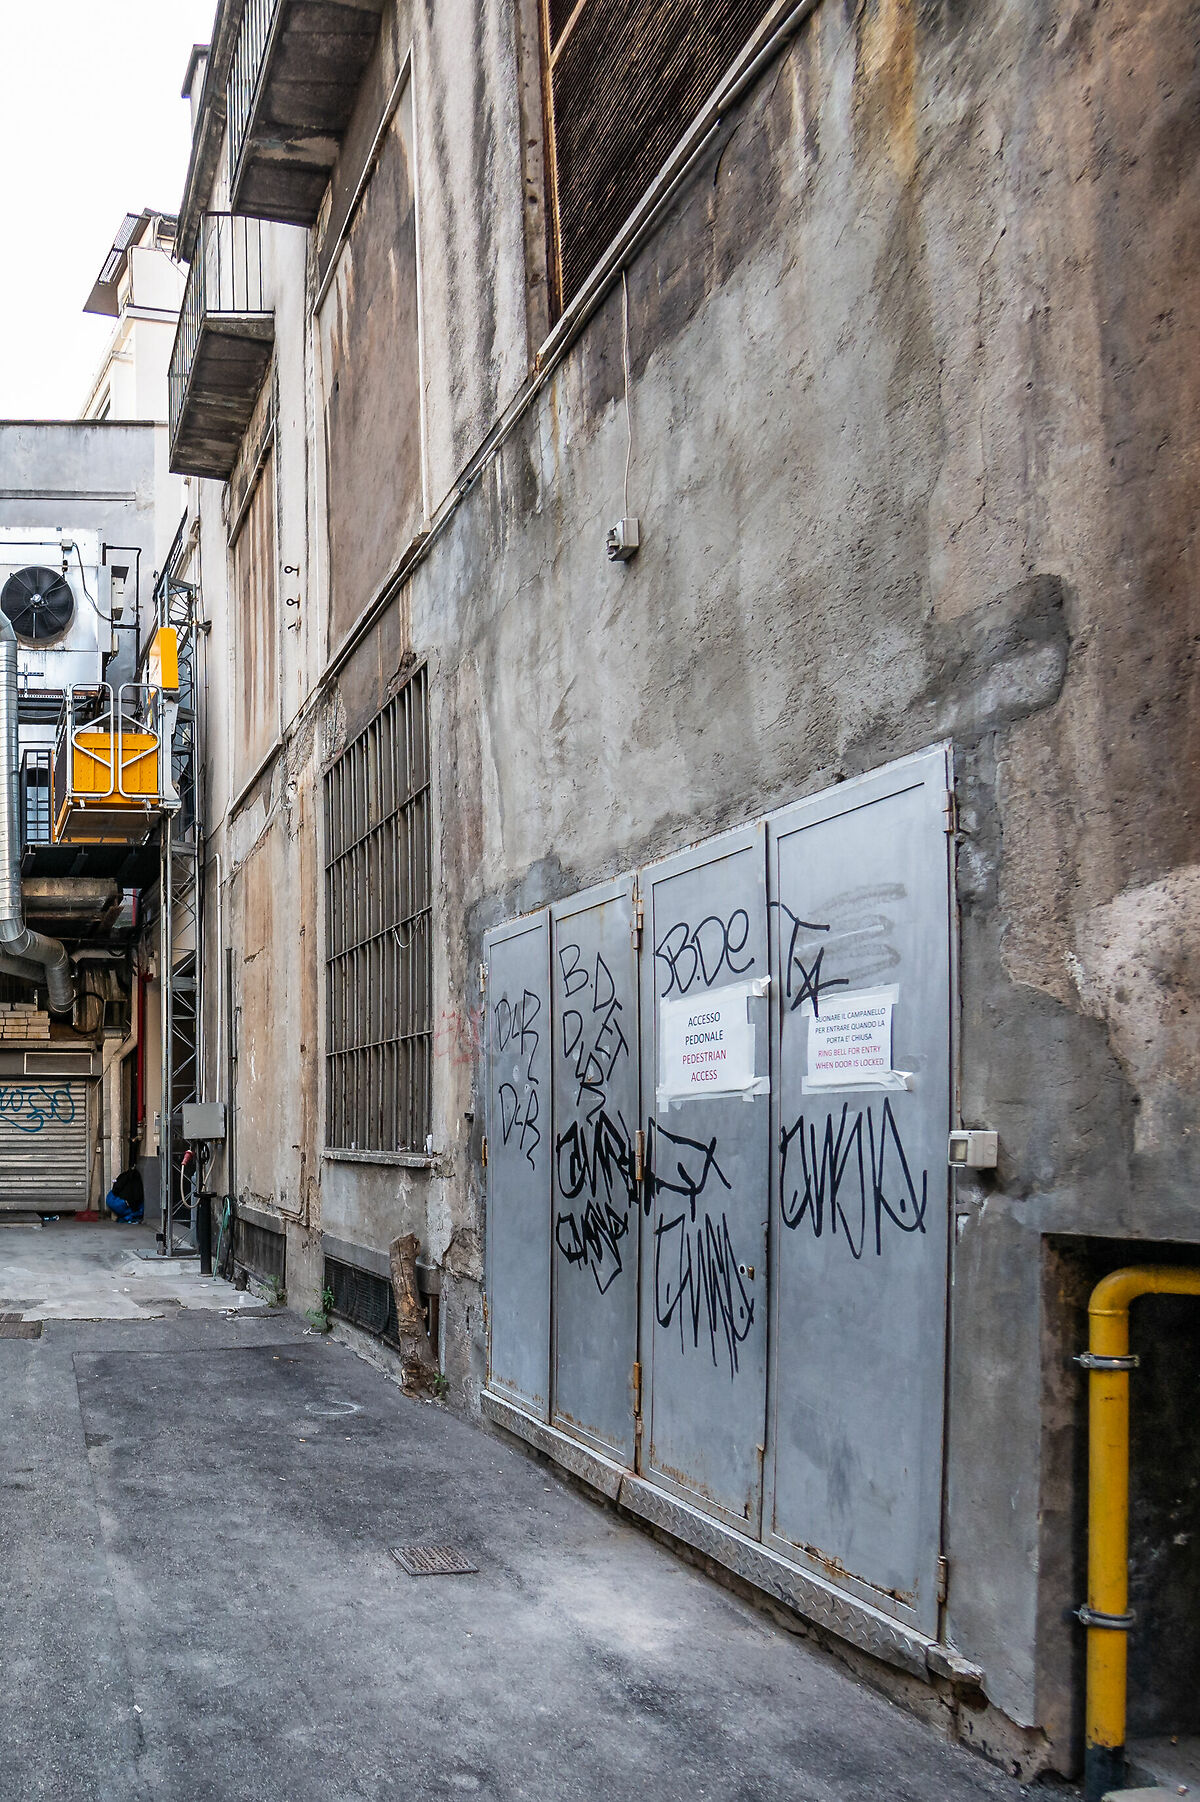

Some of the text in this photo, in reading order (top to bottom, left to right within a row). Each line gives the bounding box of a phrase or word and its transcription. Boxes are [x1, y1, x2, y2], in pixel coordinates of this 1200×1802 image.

[688, 1011, 721, 1027] ACCESSO
[847, 1007, 886, 1020] CAMPANELLO
[815, 1019, 886, 1034] PER ENTRARE QUANDO LA
[685, 1029, 724, 1046] PEDONALE
[826, 1036, 845, 1044] PORTA
[851, 1033, 873, 1042] CHIUSA
[682, 1049, 727, 1065] PEDESTRIAN
[818, 1045, 881, 1057] RING BELL FOR ENTRY
[815, 1061, 834, 1070] WHEN
[834, 1060, 853, 1069] DOOR
[860, 1058, 884, 1067] LOCKED
[690, 1069, 718, 1082] ACCESS
